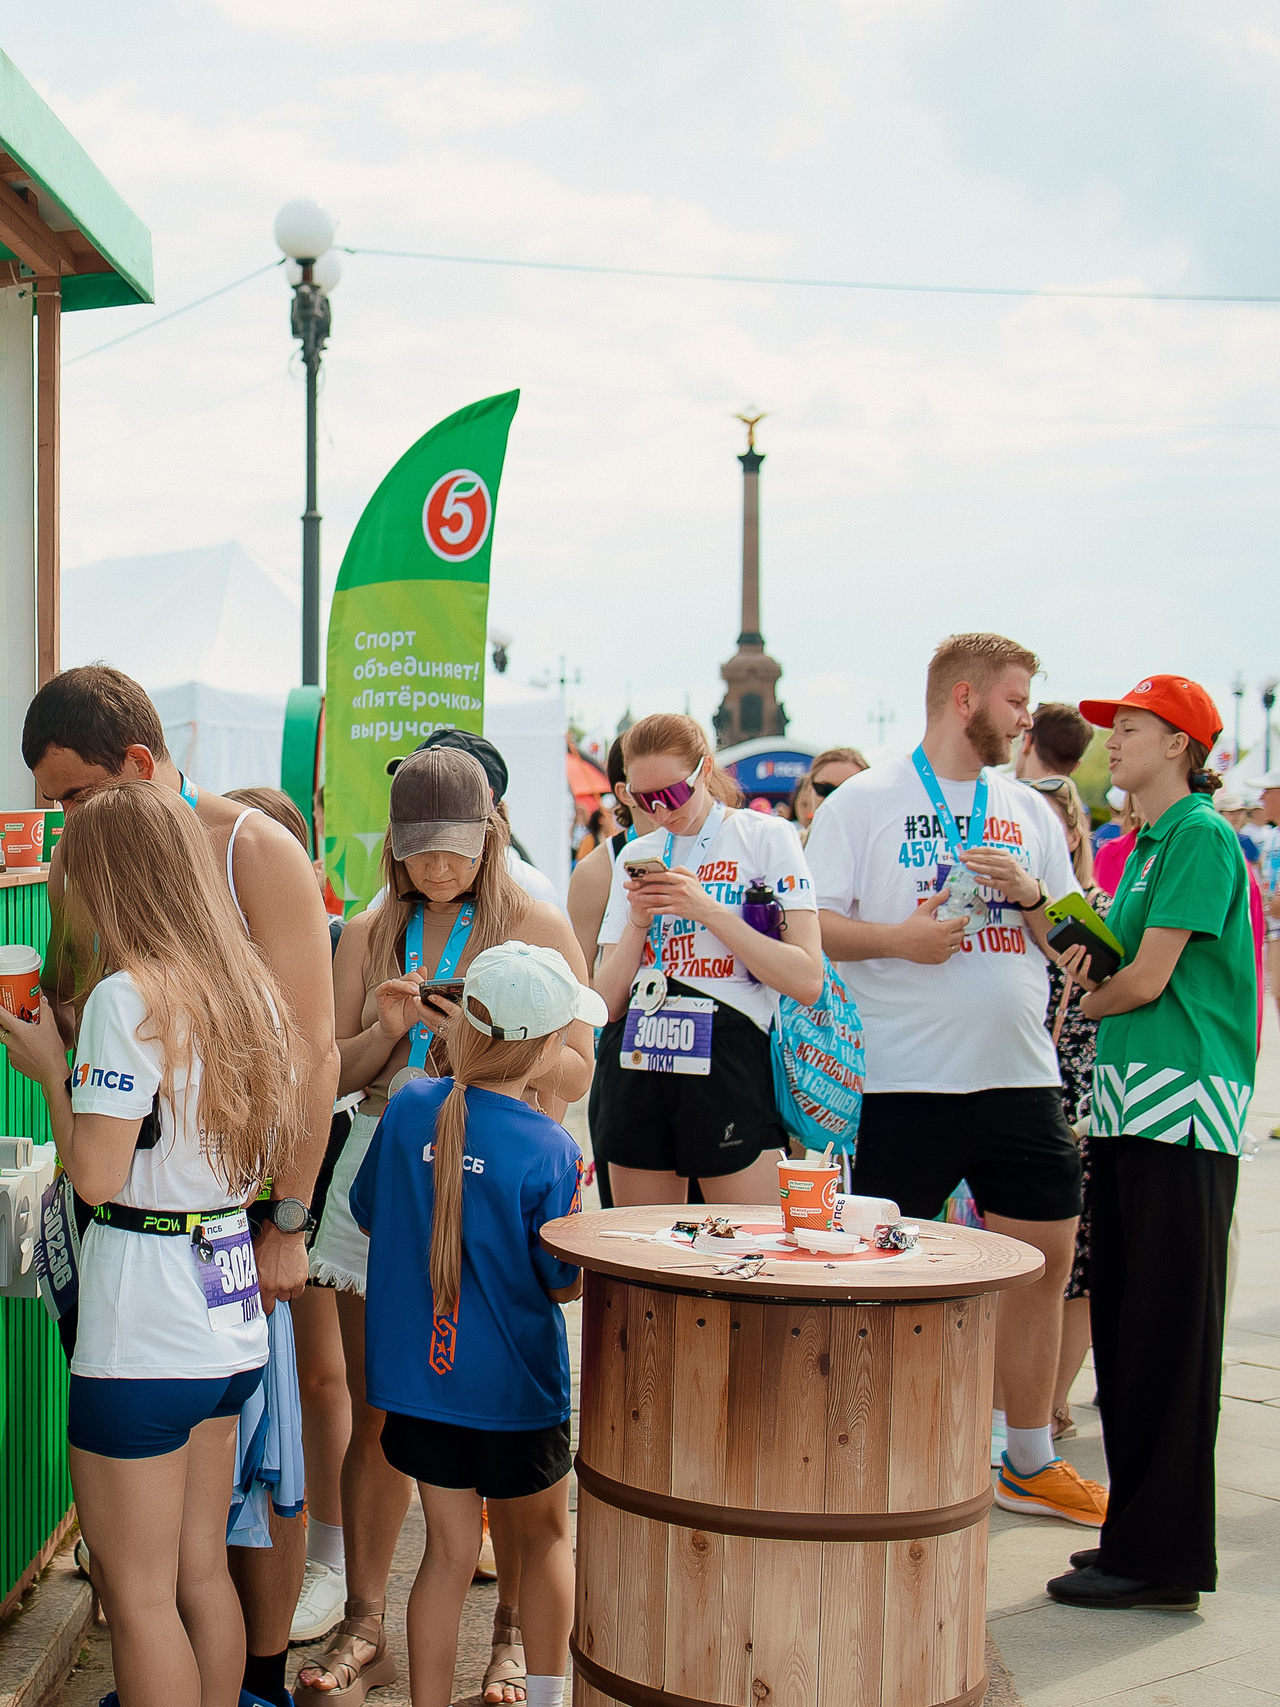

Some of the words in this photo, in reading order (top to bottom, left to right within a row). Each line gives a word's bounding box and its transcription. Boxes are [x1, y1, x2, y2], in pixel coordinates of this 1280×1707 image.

[354, 630, 417, 652] Спорт
[353, 655, 480, 682] объединяет!
[352, 684, 482, 712] «Пятёрочка»
[633, 1015, 696, 1052] 30050
[90, 1067, 136, 1094] ПСБ
[461, 1155, 486, 1175] СБ
[833, 1199, 846, 1220] ПСБ
[206, 1225, 223, 1235] ПСБ
[43, 1199, 73, 1291] 30236
